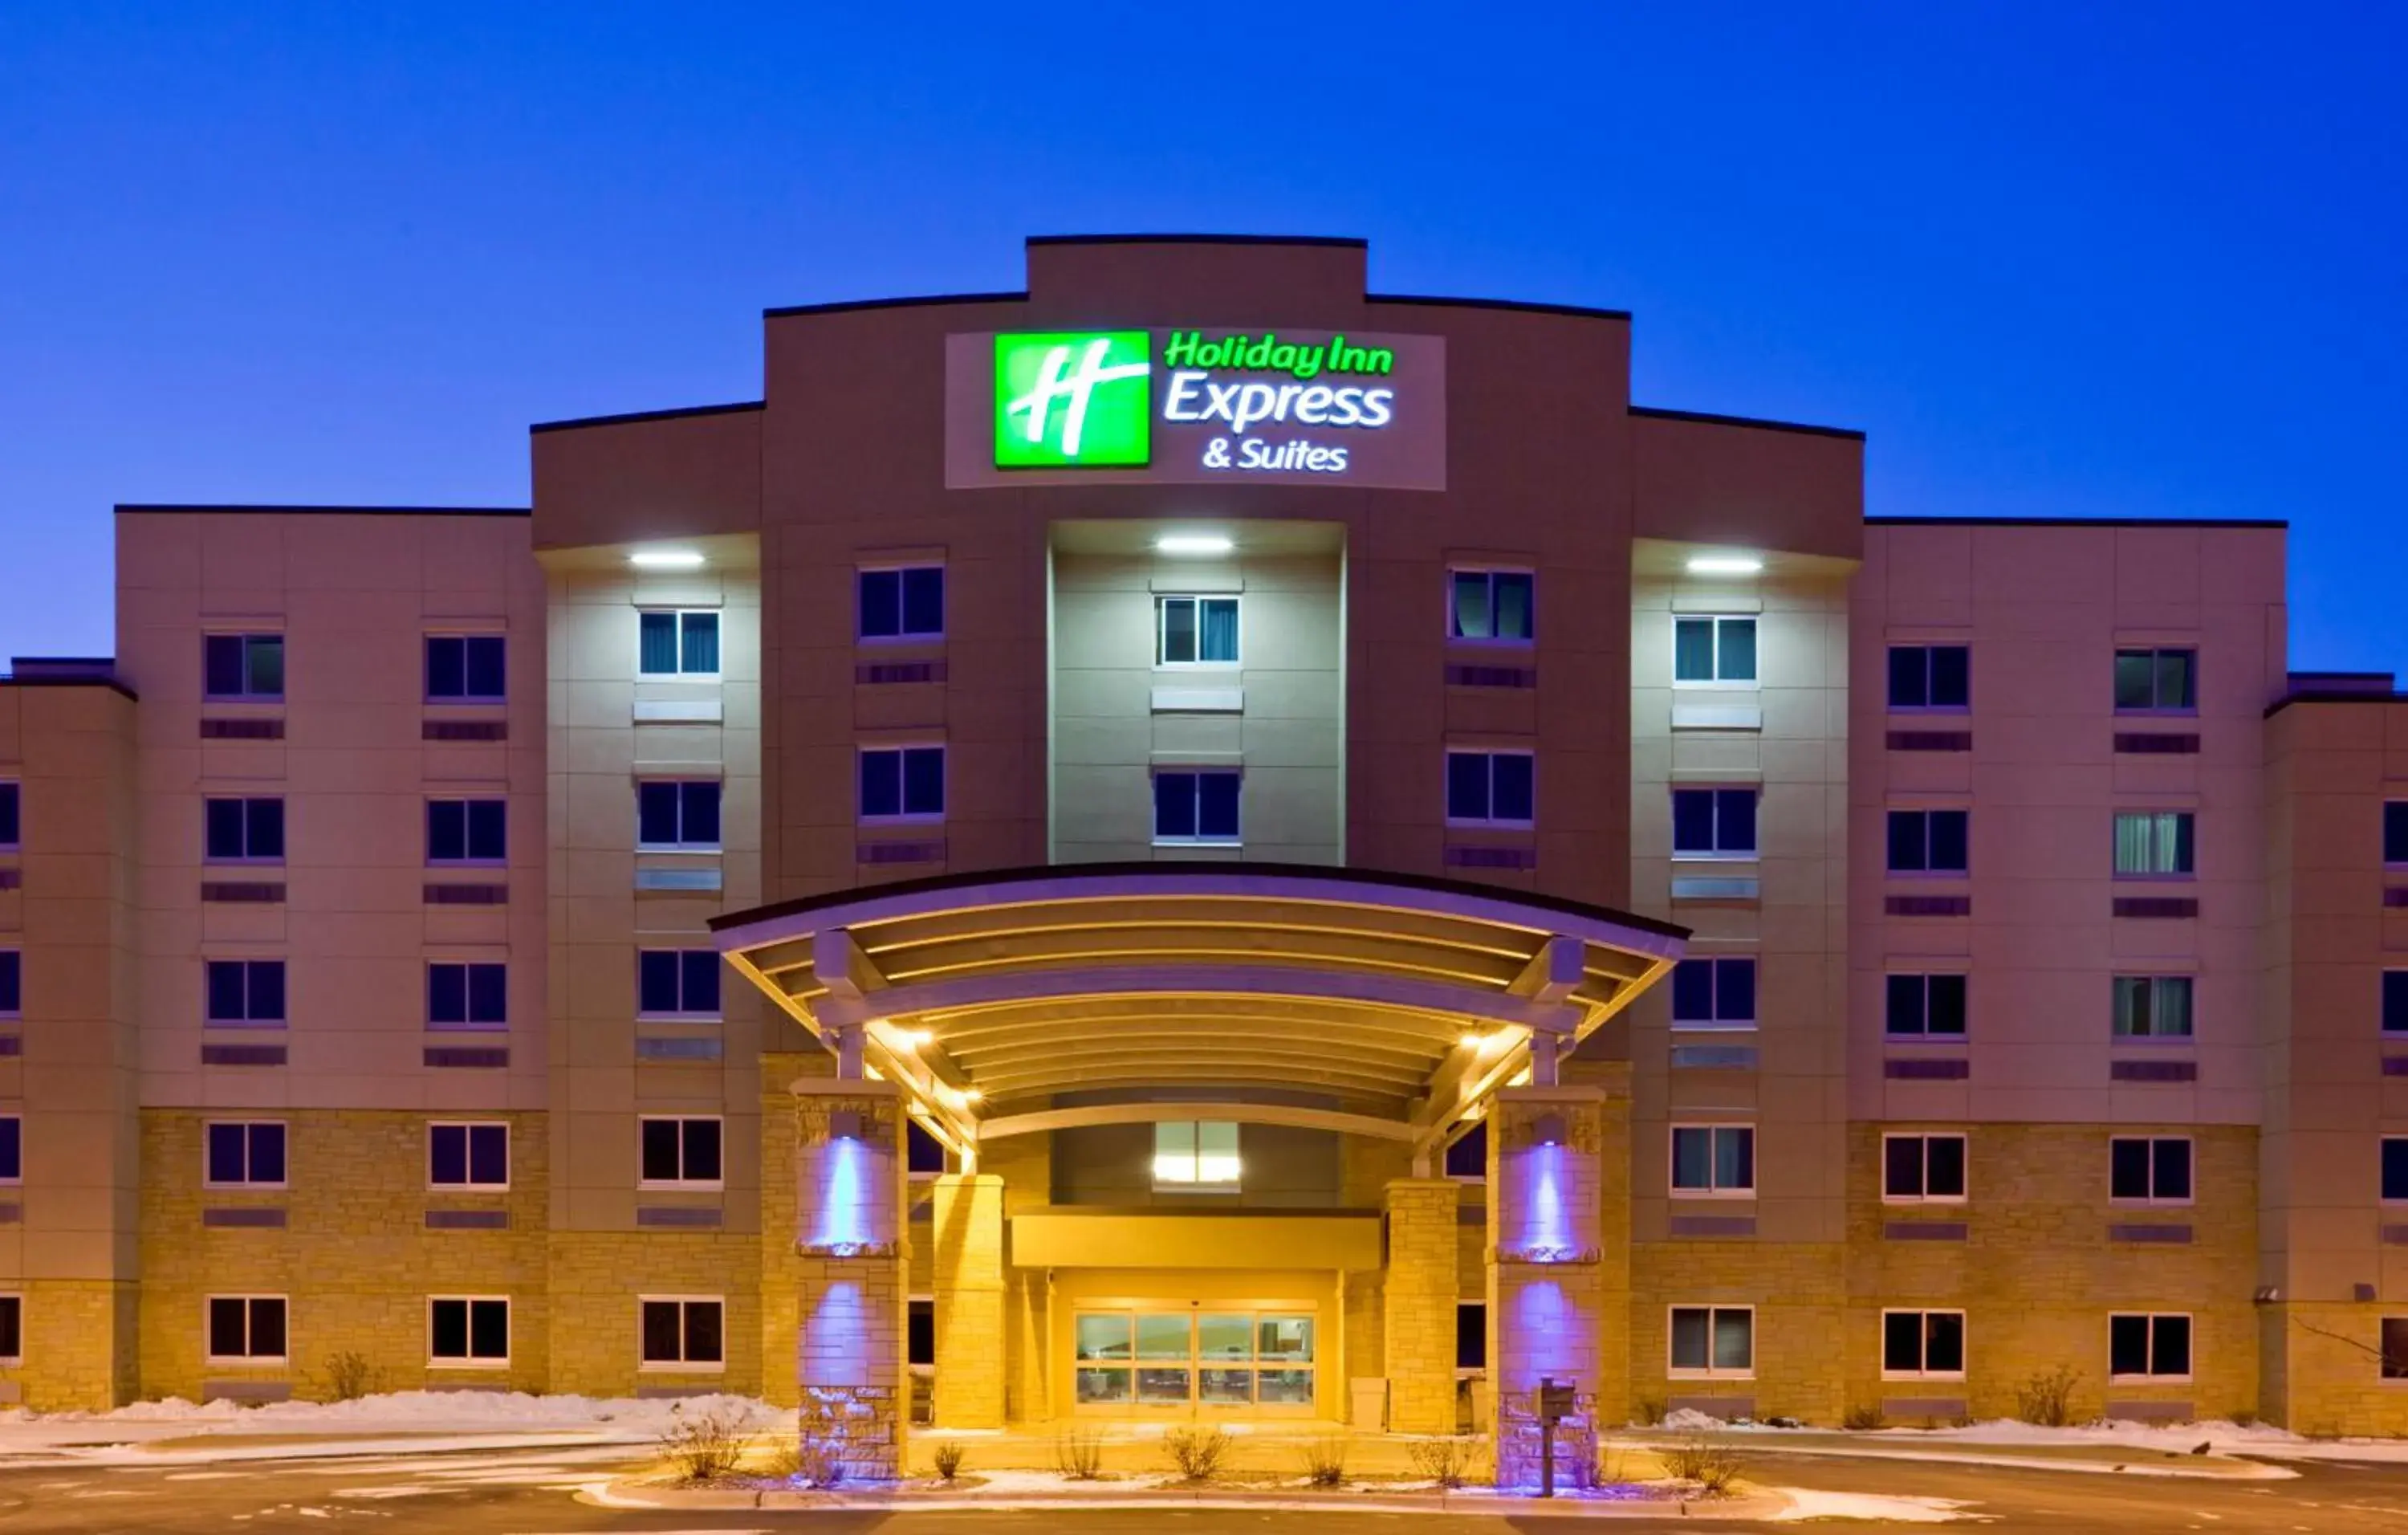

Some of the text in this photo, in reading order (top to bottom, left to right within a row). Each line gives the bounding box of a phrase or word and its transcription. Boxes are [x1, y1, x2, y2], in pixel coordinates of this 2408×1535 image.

[1164, 332, 1393, 378] Holiday Inn
[1164, 372, 1393, 434] Express
[1203, 438, 1348, 470] & Suites
